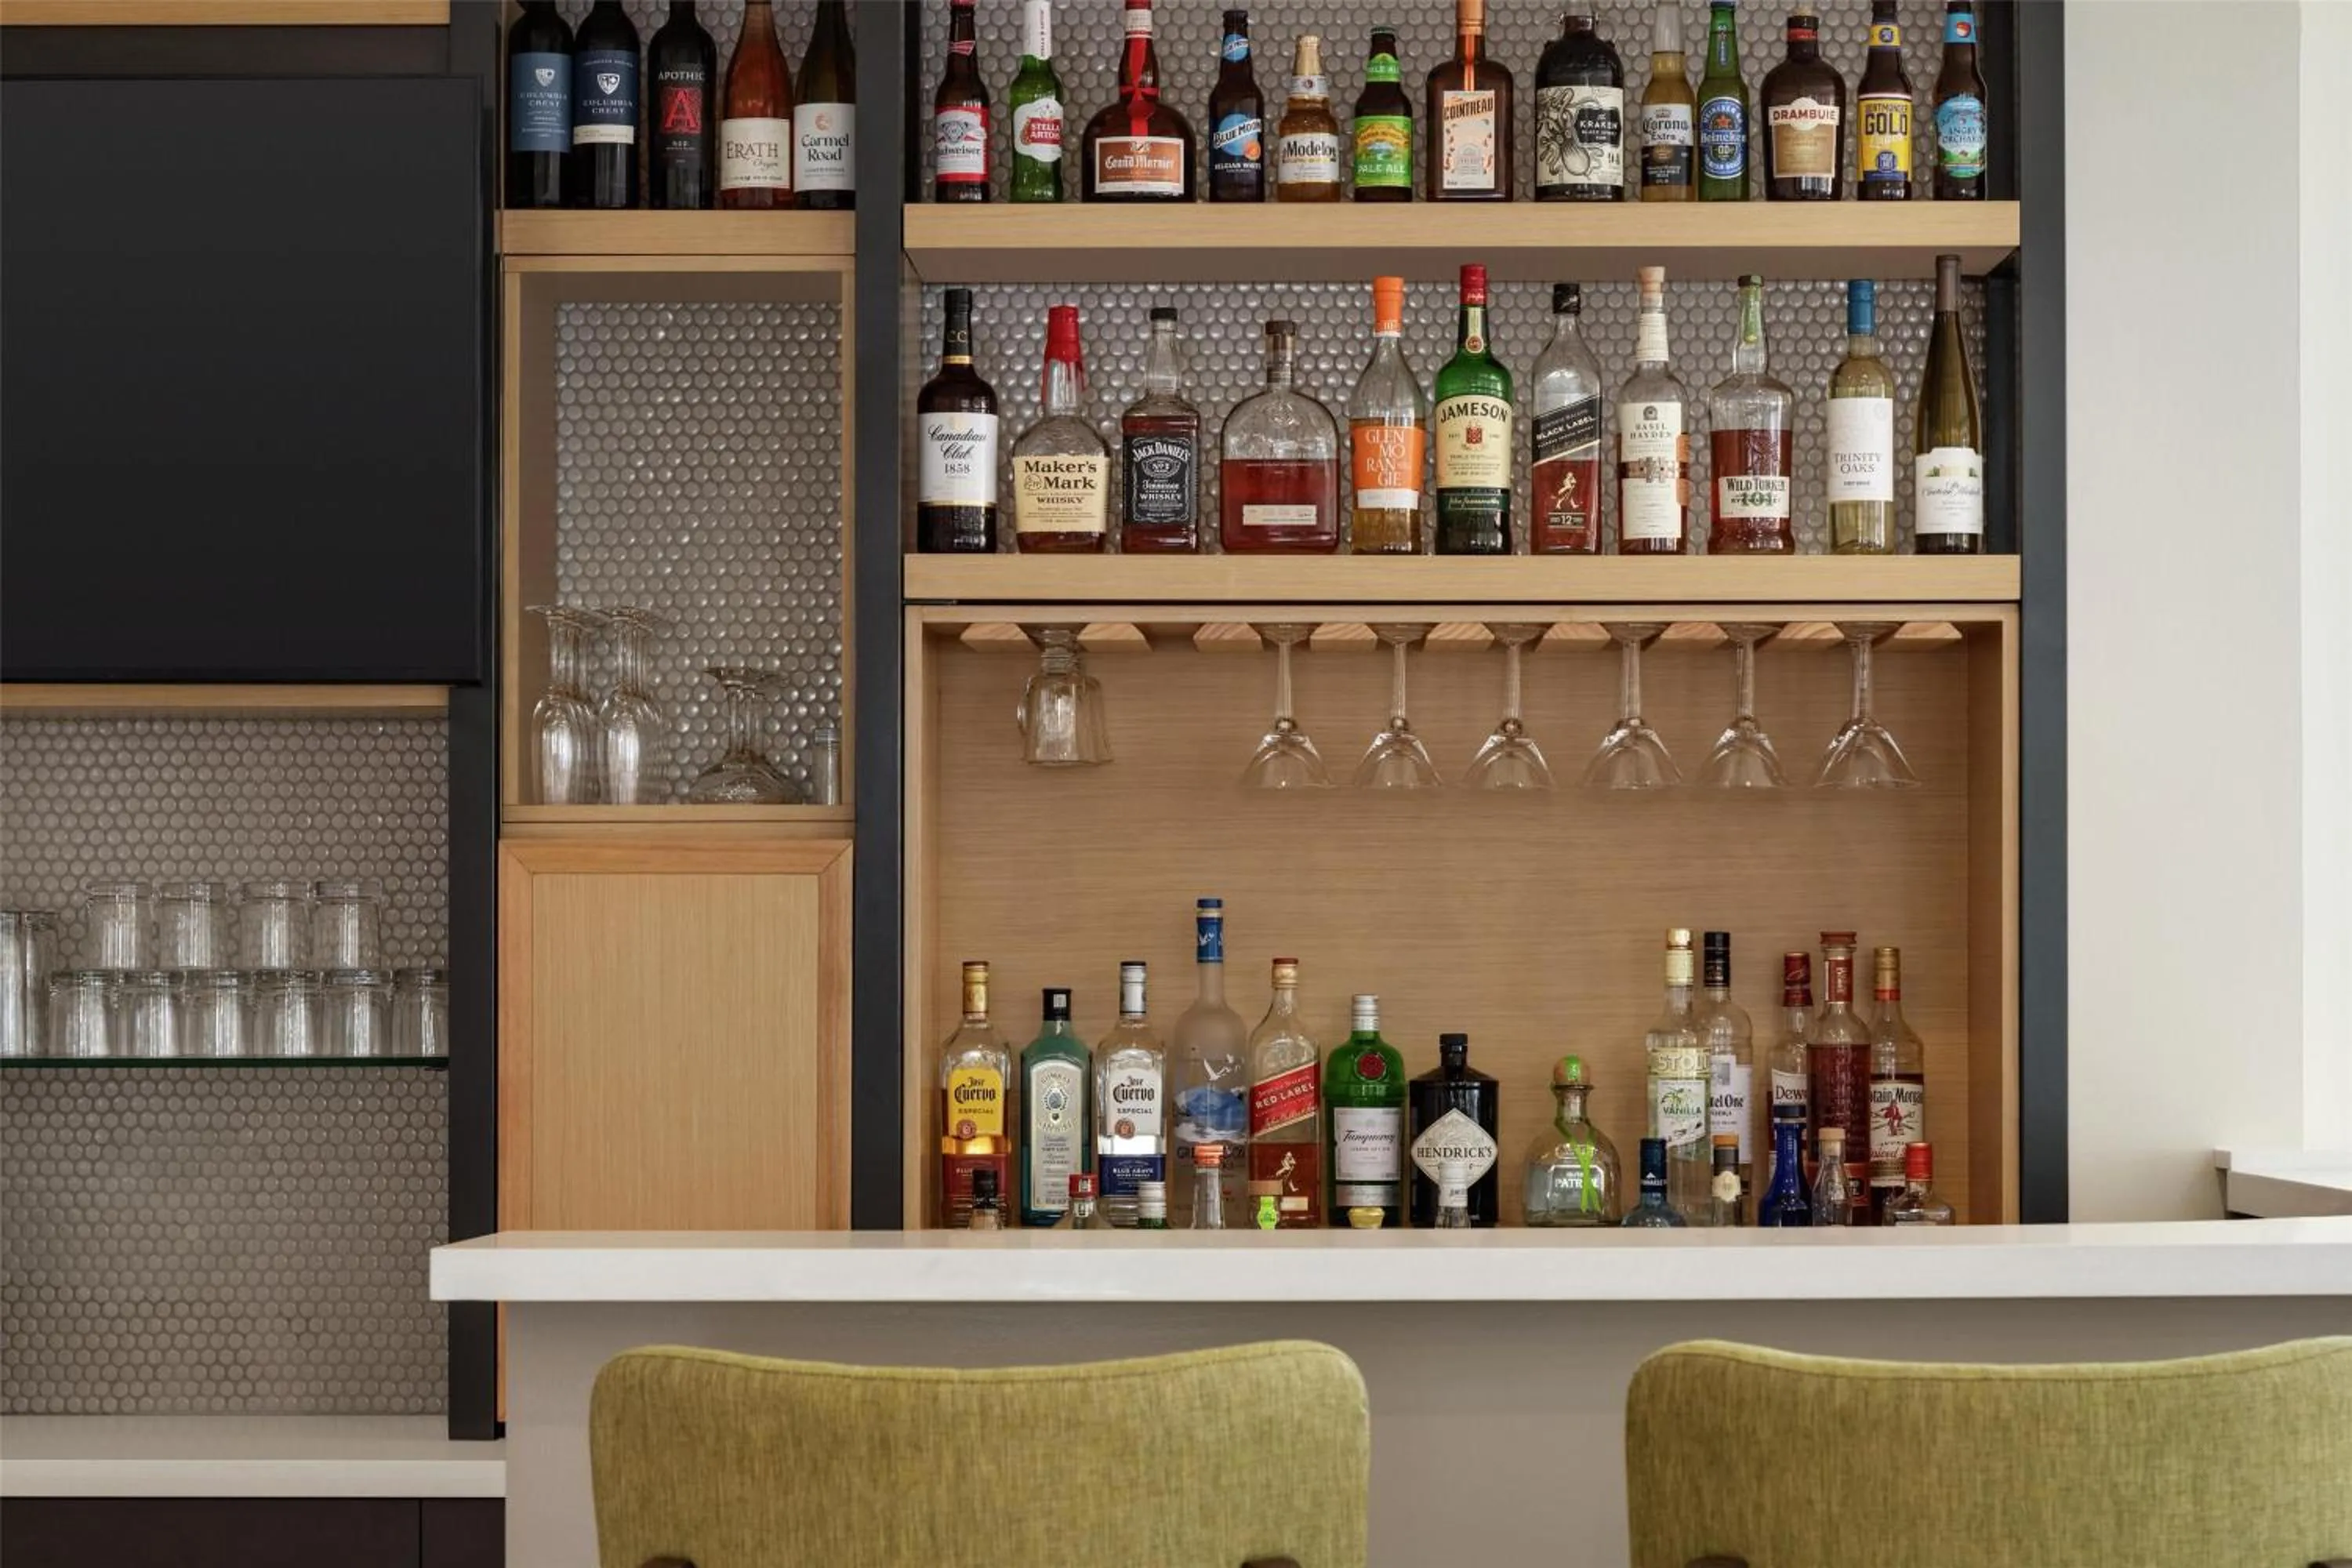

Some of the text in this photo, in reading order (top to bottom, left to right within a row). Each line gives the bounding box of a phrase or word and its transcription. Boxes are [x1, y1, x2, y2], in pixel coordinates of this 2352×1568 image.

[659, 71, 706, 81] APOTHIC
[1443, 96, 1494, 121] COINTREAU
[1773, 108, 1836, 121] DRAMBUIE
[1580, 120, 1618, 129] KRAKEN
[1642, 118, 1689, 134] Corona
[1865, 113, 1907, 136] GOLD
[800, 132, 850, 147] Carmel
[1214, 119, 1261, 147] BLUE MOON
[1650, 131, 1676, 141] Extra
[1702, 130, 1746, 143] Heineken
[1942, 135, 1983, 143] ORCHARD
[727, 140, 779, 161] ERATH
[808, 147, 843, 162] Road
[939, 144, 981, 155] dweiser
[1286, 140, 1334, 157] Modelo
[1105, 154, 1175, 170] Grand Marnier
[1357, 164, 1406, 174] PALE ALE
[1440, 402, 1508, 423] JAMESON
[927, 423, 987, 441] Canadian
[1536, 425, 1565, 440] BLACK
[1566, 415, 1597, 430] LABEL
[1364, 429, 1405, 444] GLEN
[940, 441, 975, 459] Club
[1132, 441, 1191, 462] JACK DANIEL'S
[1378, 443, 1406, 459] MO
[1834, 452, 1882, 463] TRINITY
[944, 463, 971, 474] 1858
[1024, 460, 1098, 474] Maker's
[1367, 458, 1396, 472] RAN
[1840, 463, 1876, 474] OAKS
[1043, 476, 1097, 490] Mark
[1377, 472, 1403, 487] GIE
[1726, 477, 1753, 492] WILD
[1740, 492, 1773, 507] 101
[1561, 515, 1573, 524] 12
[1657, 1051, 1708, 1072] STOLI
[967, 1076, 985, 1088] Jose
[1127, 1075, 1145, 1087] Jose
[953, 1083, 997, 1105] Cuervo
[1112, 1083, 1156, 1105] Cuervo
[1255, 1095, 1278, 1109] RED
[1279, 1083, 1316, 1101] LABEL
[1710, 1094, 1744, 1108] tel One
[1870, 1087, 1923, 1105] tain Morga
[1663, 1103, 1702, 1116] VANILLA
[1342, 1130, 1396, 1145] Tanqueray
[1416, 1146, 1493, 1158] HENDRICK'S
[1555, 1178, 1599, 1189] PATRN
